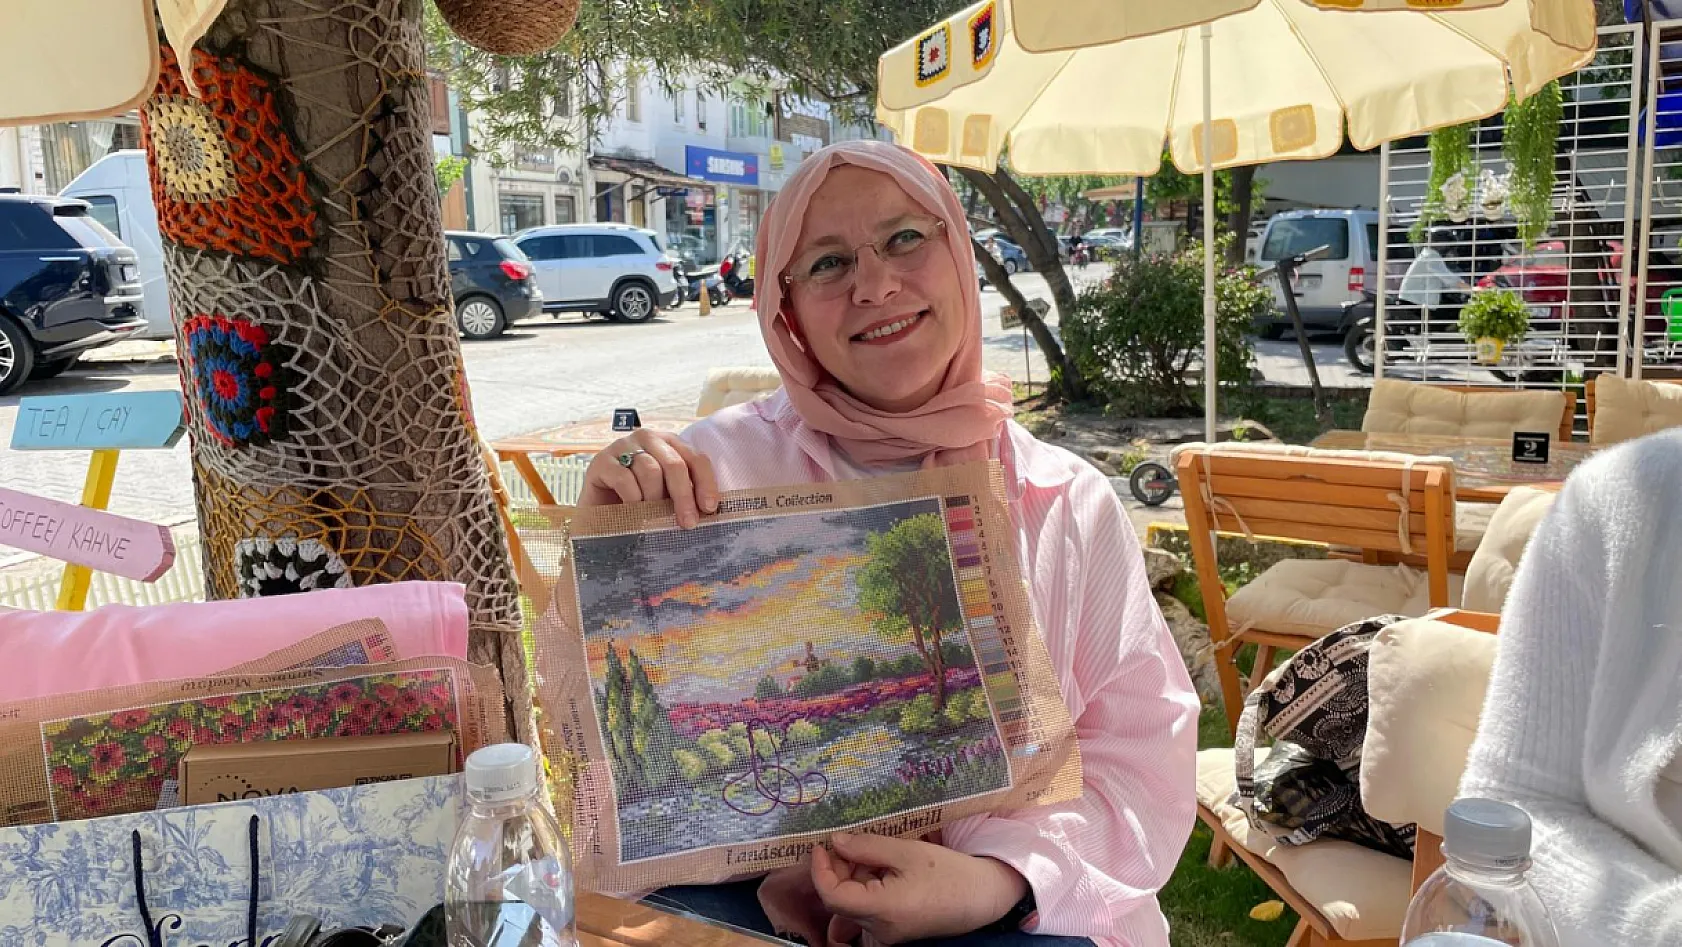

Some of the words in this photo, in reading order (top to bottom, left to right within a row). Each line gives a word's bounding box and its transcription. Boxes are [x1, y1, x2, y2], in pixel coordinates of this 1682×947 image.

[28, 405, 70, 440] TEA
[1523, 440, 1538, 457] 2
[775, 492, 833, 508] Collection
[0, 502, 64, 545] OFFEE/
[68, 521, 131, 560] KAHVE
[726, 844, 814, 865] Landscape
